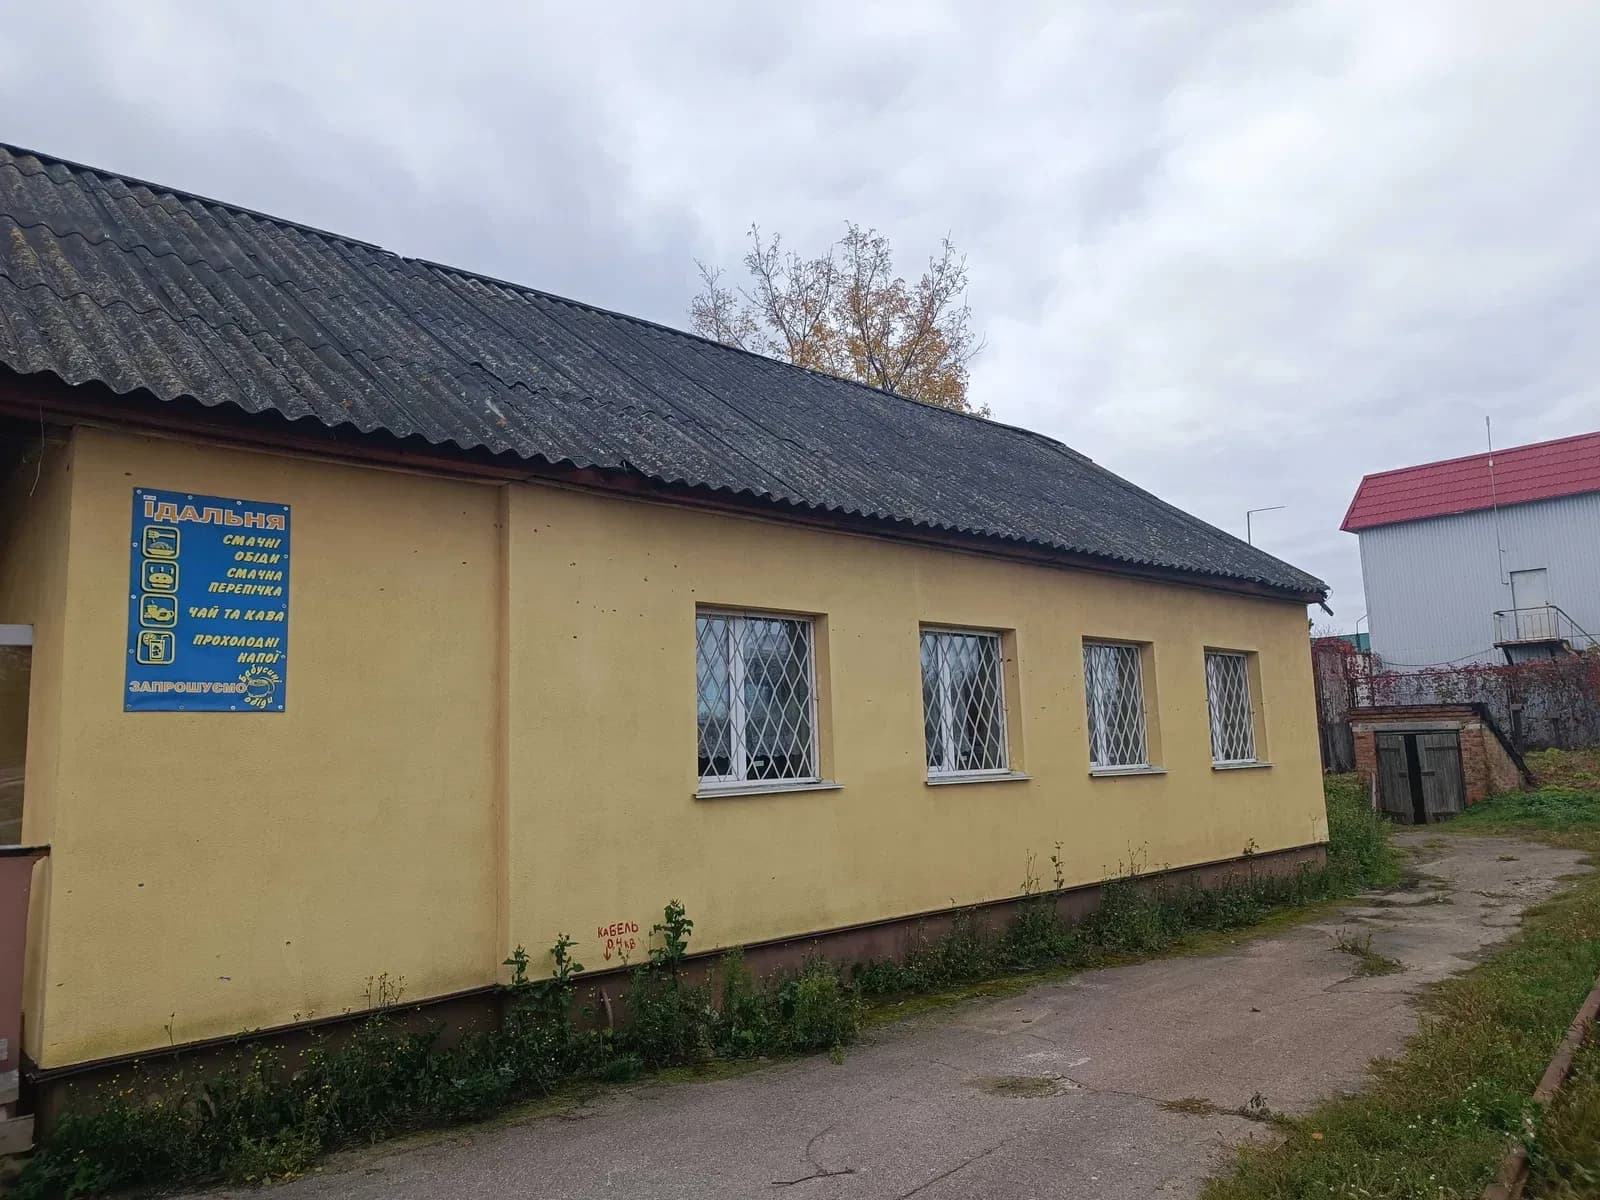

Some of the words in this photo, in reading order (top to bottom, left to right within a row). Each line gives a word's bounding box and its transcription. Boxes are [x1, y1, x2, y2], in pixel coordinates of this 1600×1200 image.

[143, 495, 285, 530] ЇДАЛЬНЯ
[223, 534, 281, 549] СМАЧНІ
[234, 551, 280, 564] ОБІДИ
[227, 567, 282, 582] СМАЧНА
[208, 582, 282, 597] ПЕРЕПІЧКА
[189, 605, 219, 619] ЧАЙ
[224, 609, 240, 620] ТА
[244, 610, 284, 622] КАВА
[193, 634, 279, 648] ПРОХОЛОДНІ
[237, 650, 282, 664] НАПОЇ
[129, 680, 248, 694] ЗАПРОШУЄМО
[597, 921, 639, 938] КАБЕЛЬ
